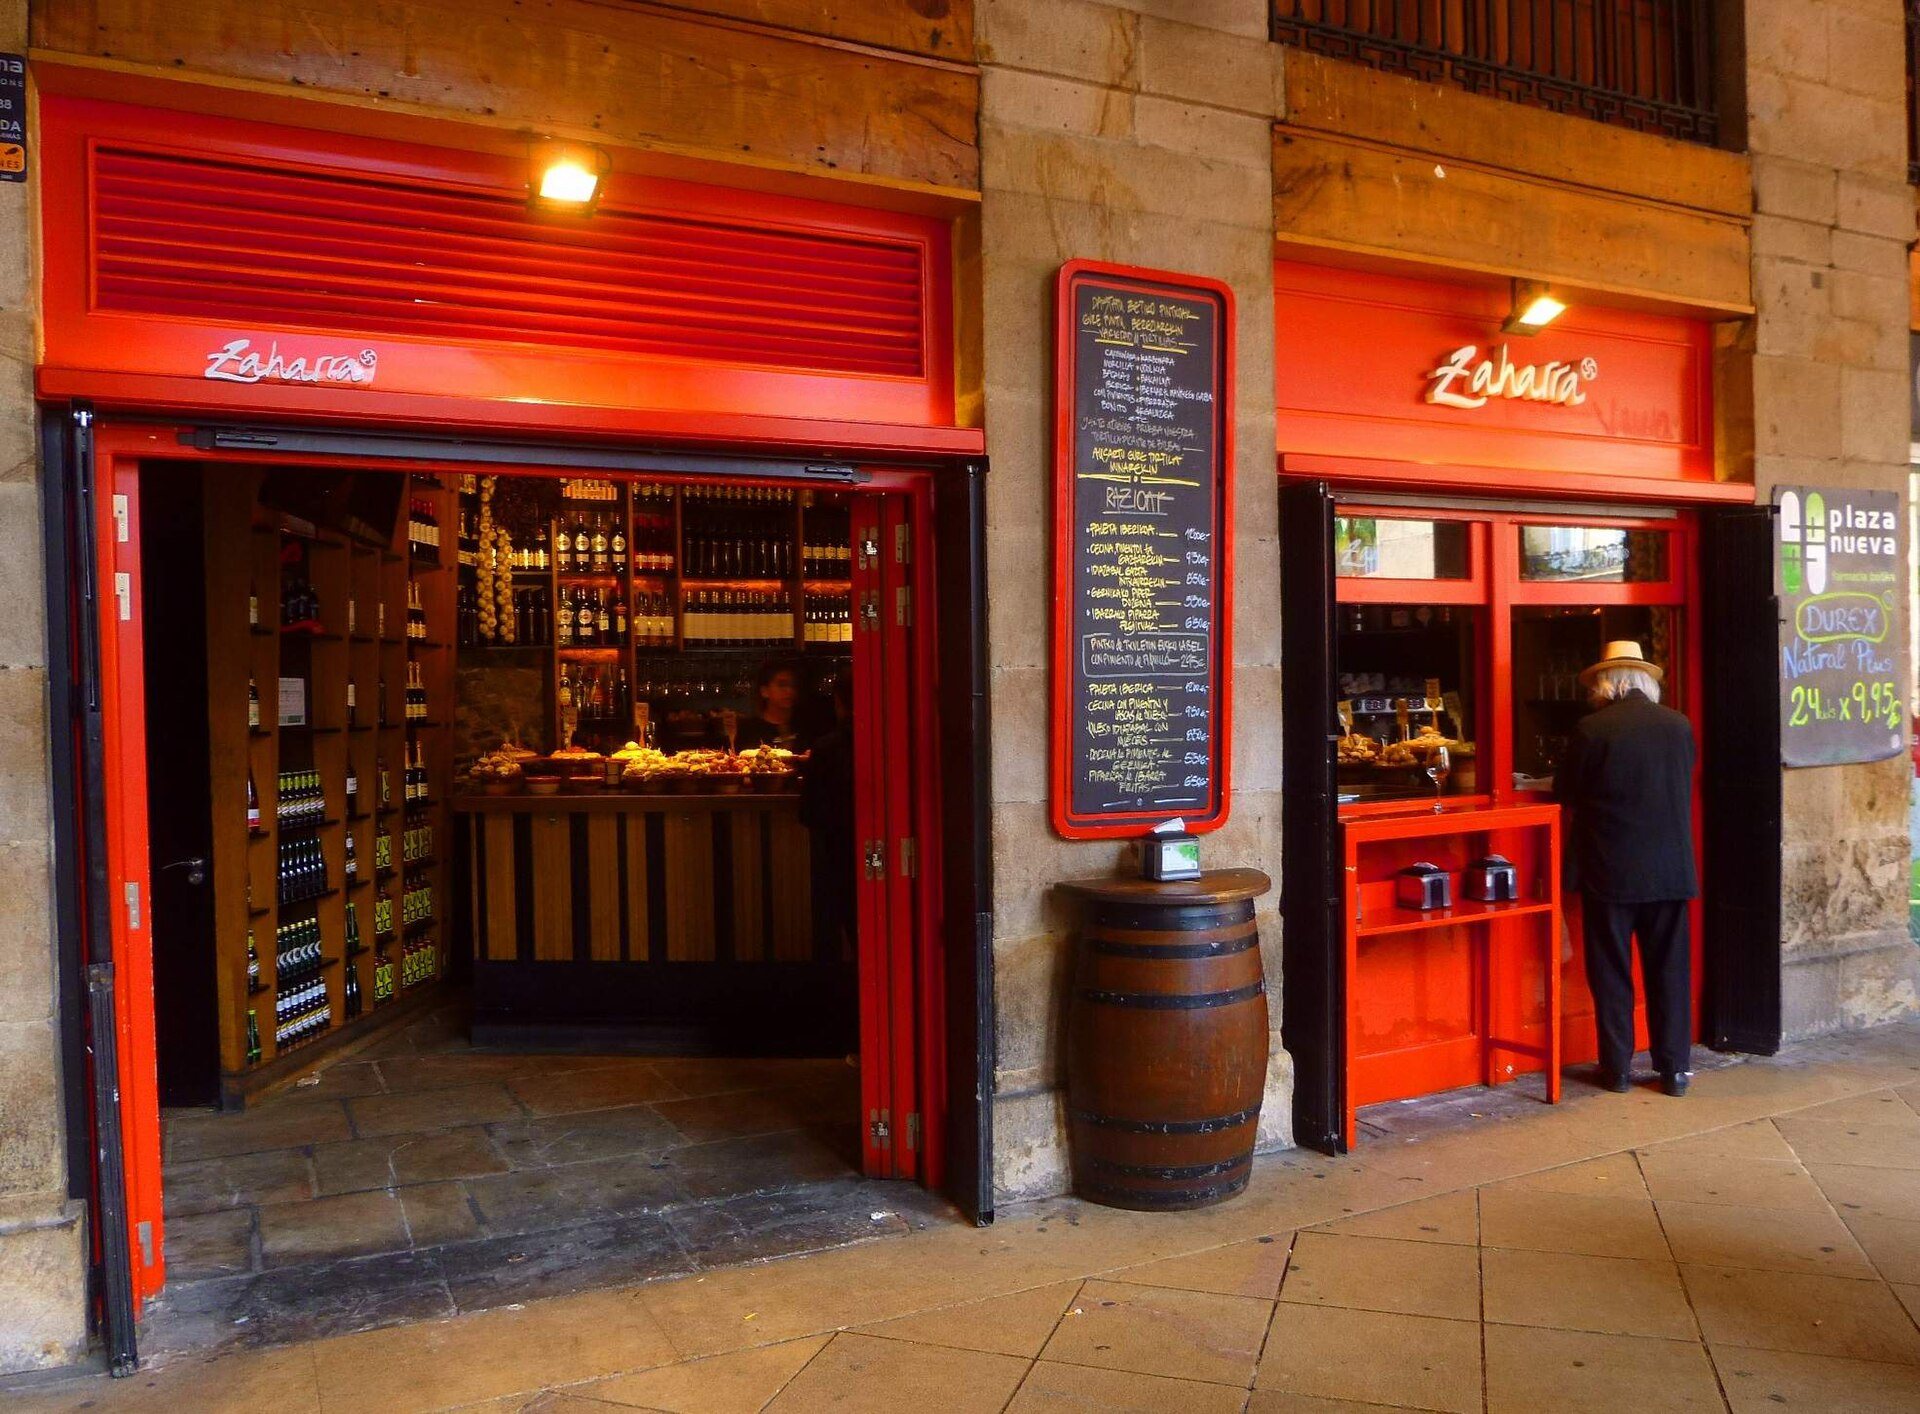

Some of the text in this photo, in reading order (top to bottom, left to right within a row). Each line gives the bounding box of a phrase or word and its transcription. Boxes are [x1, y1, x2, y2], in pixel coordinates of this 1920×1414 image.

[205, 339, 365, 383] Zaharra
[1427, 342, 1586, 410] Zaharra
[1830, 504, 1895, 533] plaza
[1830, 535, 1896, 555] nueva
[1804, 605, 1878, 634] DUREX
[1783, 636, 1893, 679] Natural Plus
